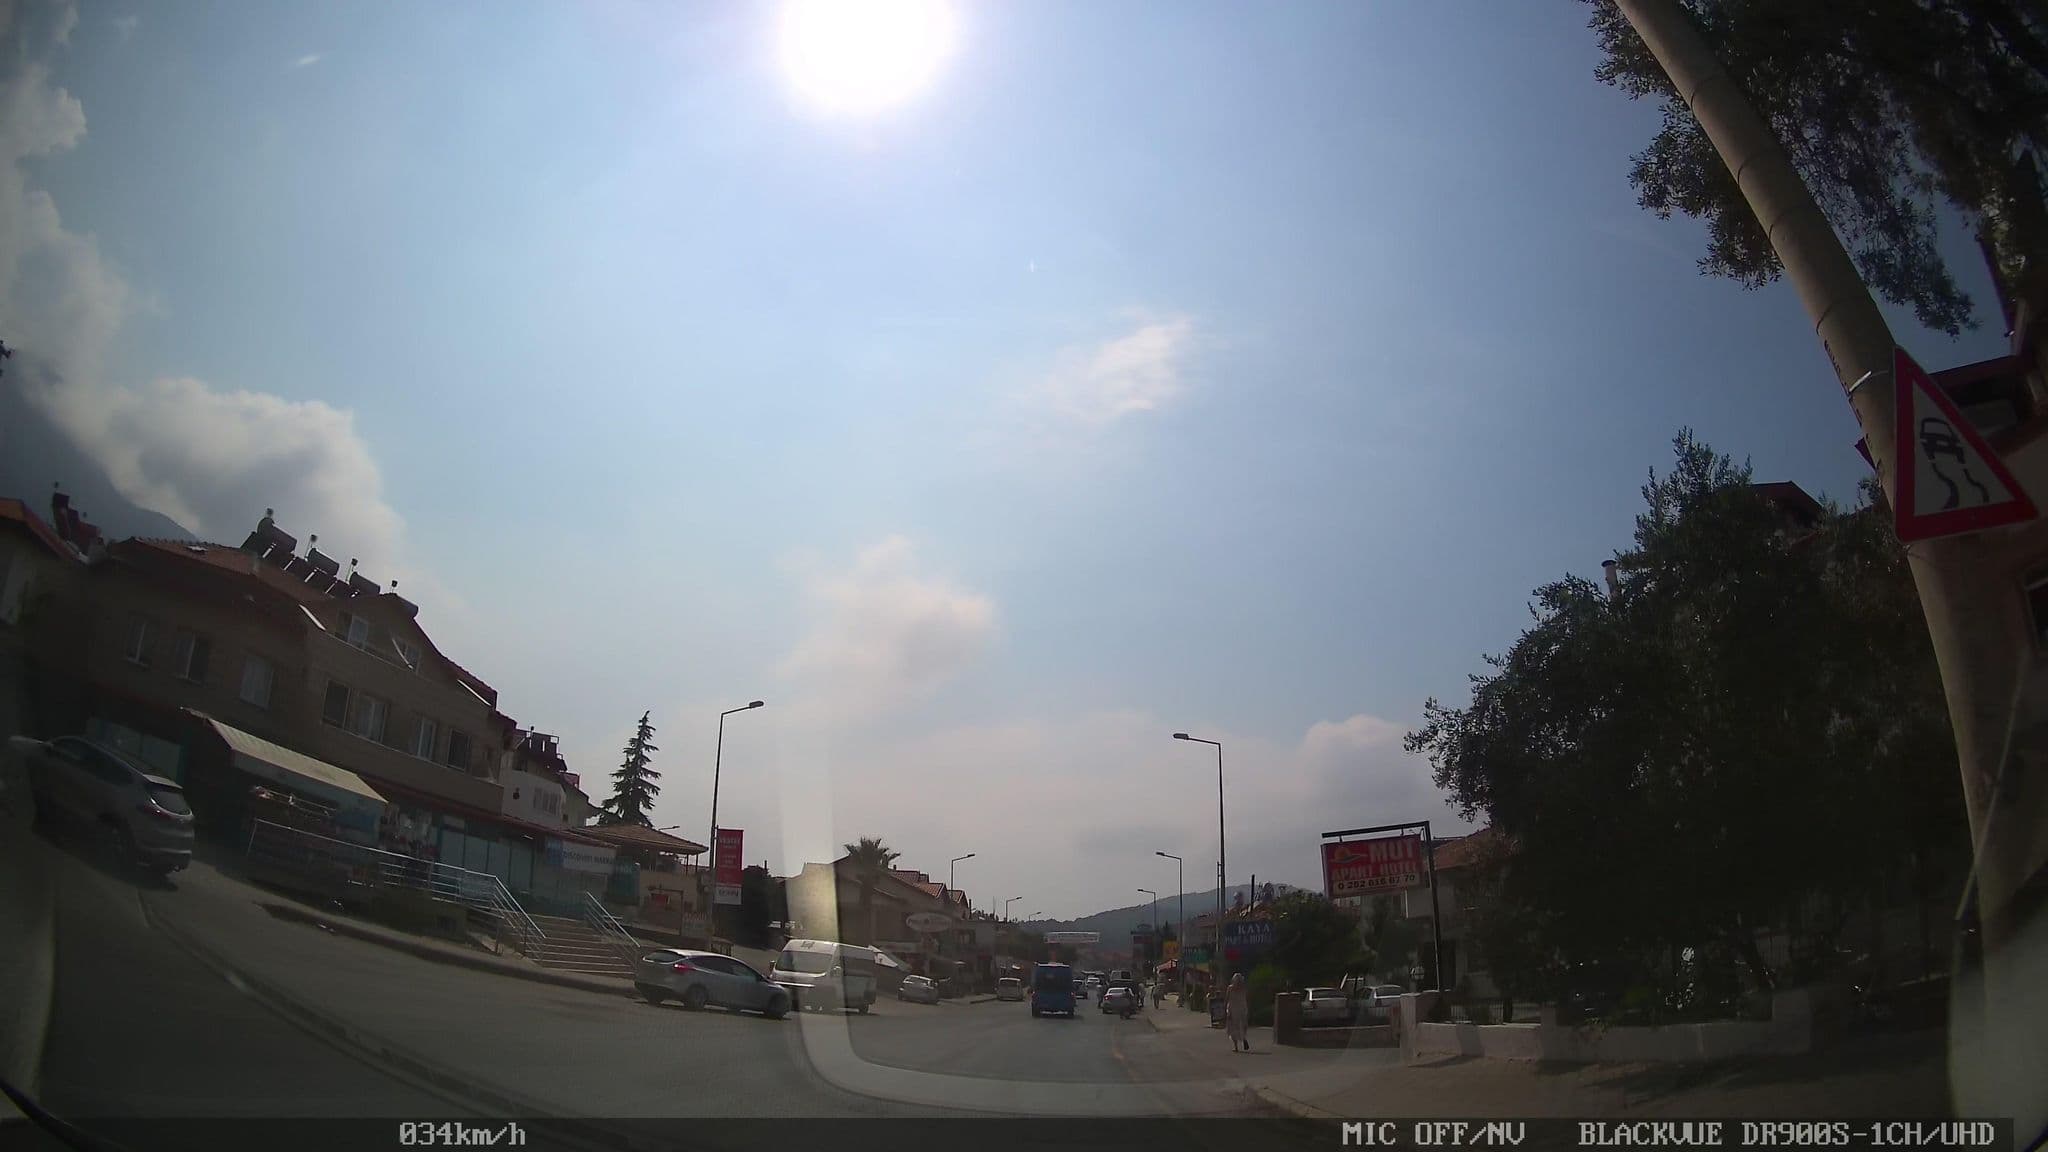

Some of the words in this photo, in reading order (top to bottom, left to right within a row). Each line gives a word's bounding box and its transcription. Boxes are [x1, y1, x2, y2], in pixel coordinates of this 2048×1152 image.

[1368, 839, 1415, 863] MUT
[1332, 864, 1373, 880] APART
[1380, 860, 1417, 875] HOTEL
[1237, 923, 1271, 935] KAYA
